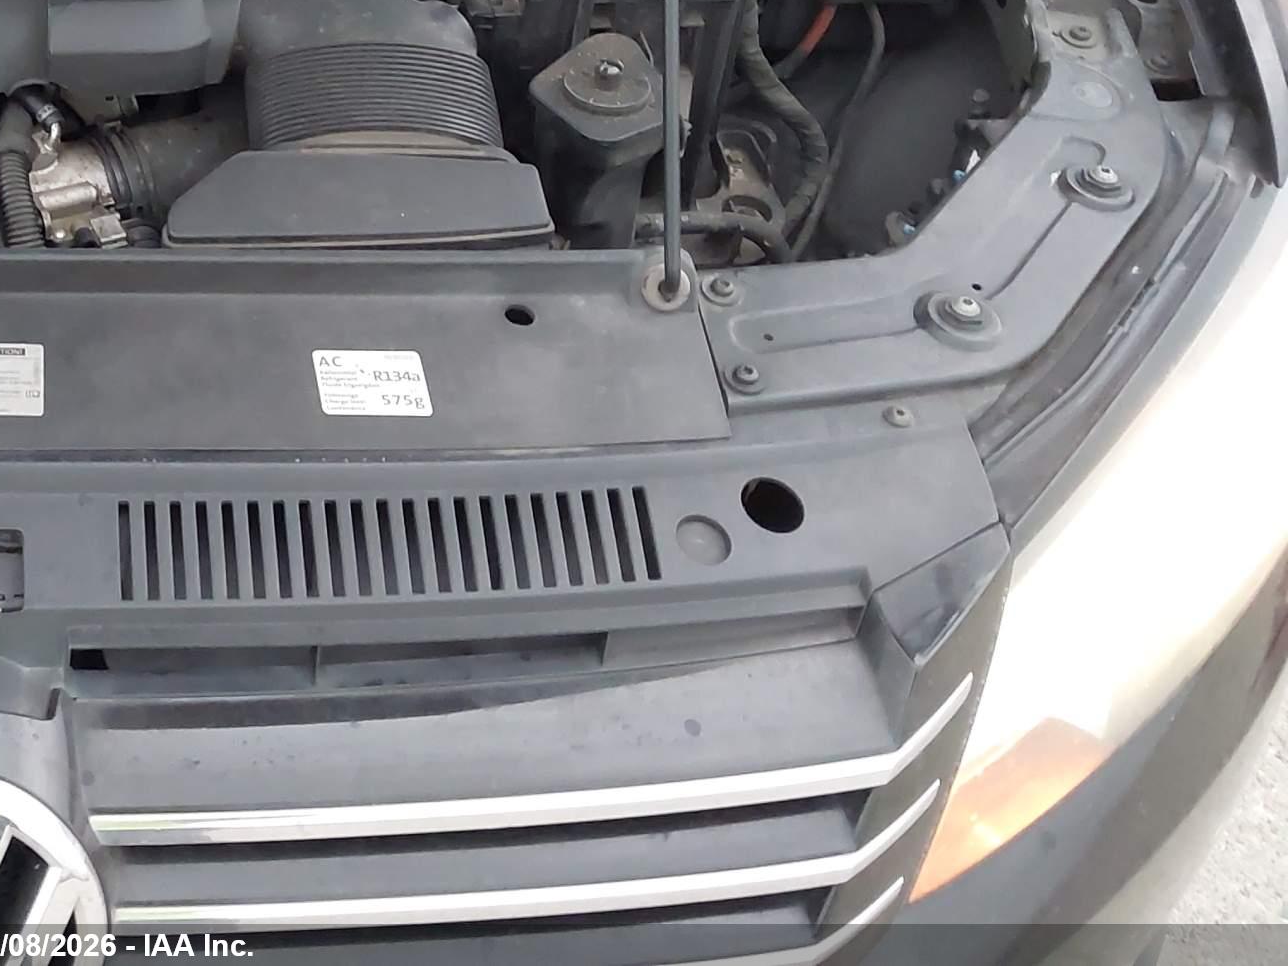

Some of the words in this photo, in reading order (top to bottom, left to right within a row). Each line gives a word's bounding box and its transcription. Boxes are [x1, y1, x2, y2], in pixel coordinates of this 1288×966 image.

[319, 355, 343, 367] AC
[372, 370, 421, 382] R134a
[381, 394, 425, 410] 575g
